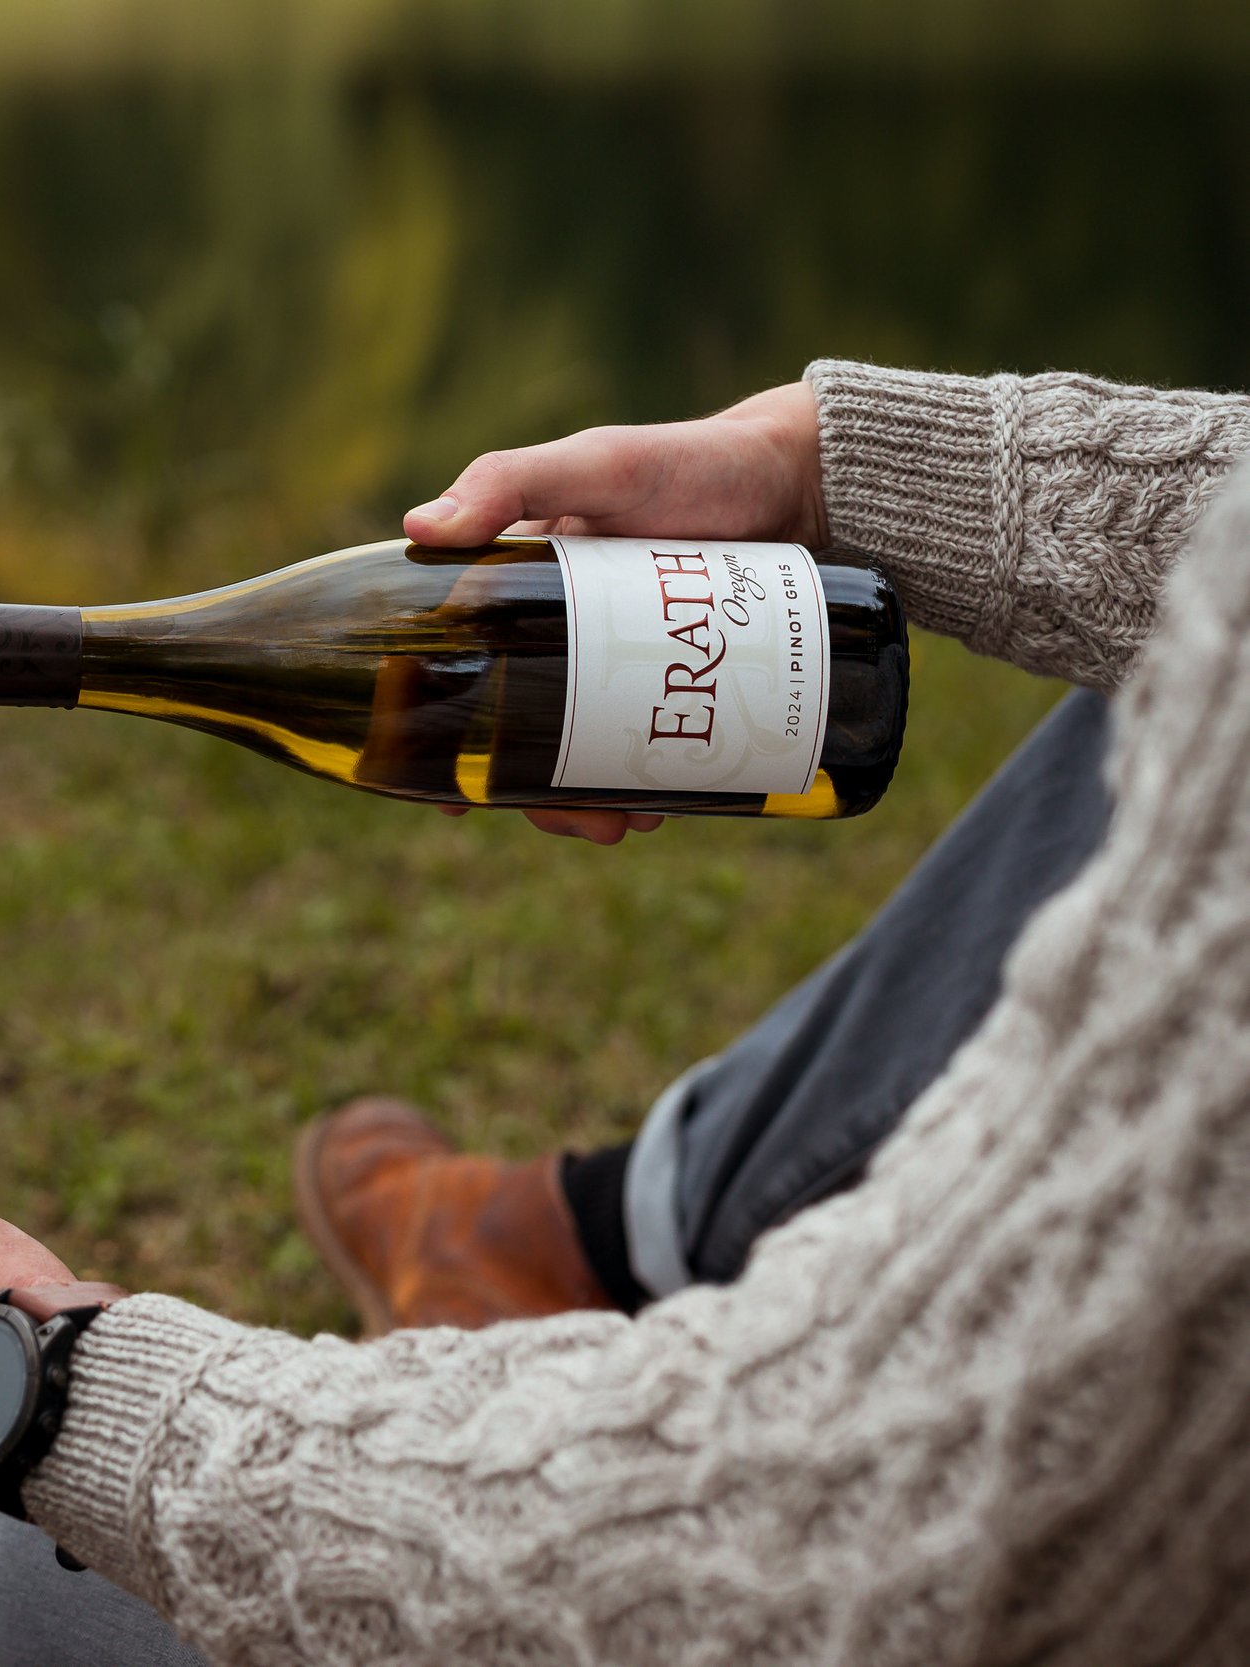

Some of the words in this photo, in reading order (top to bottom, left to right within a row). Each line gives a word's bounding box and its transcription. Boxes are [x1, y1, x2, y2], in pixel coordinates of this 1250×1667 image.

[721, 554, 766, 627] Oregon
[778, 563, 798, 600] GRIS
[648, 549, 726, 747] ERATH
[787, 608, 803, 672] PINOT
[785, 689, 802, 737] 2024
